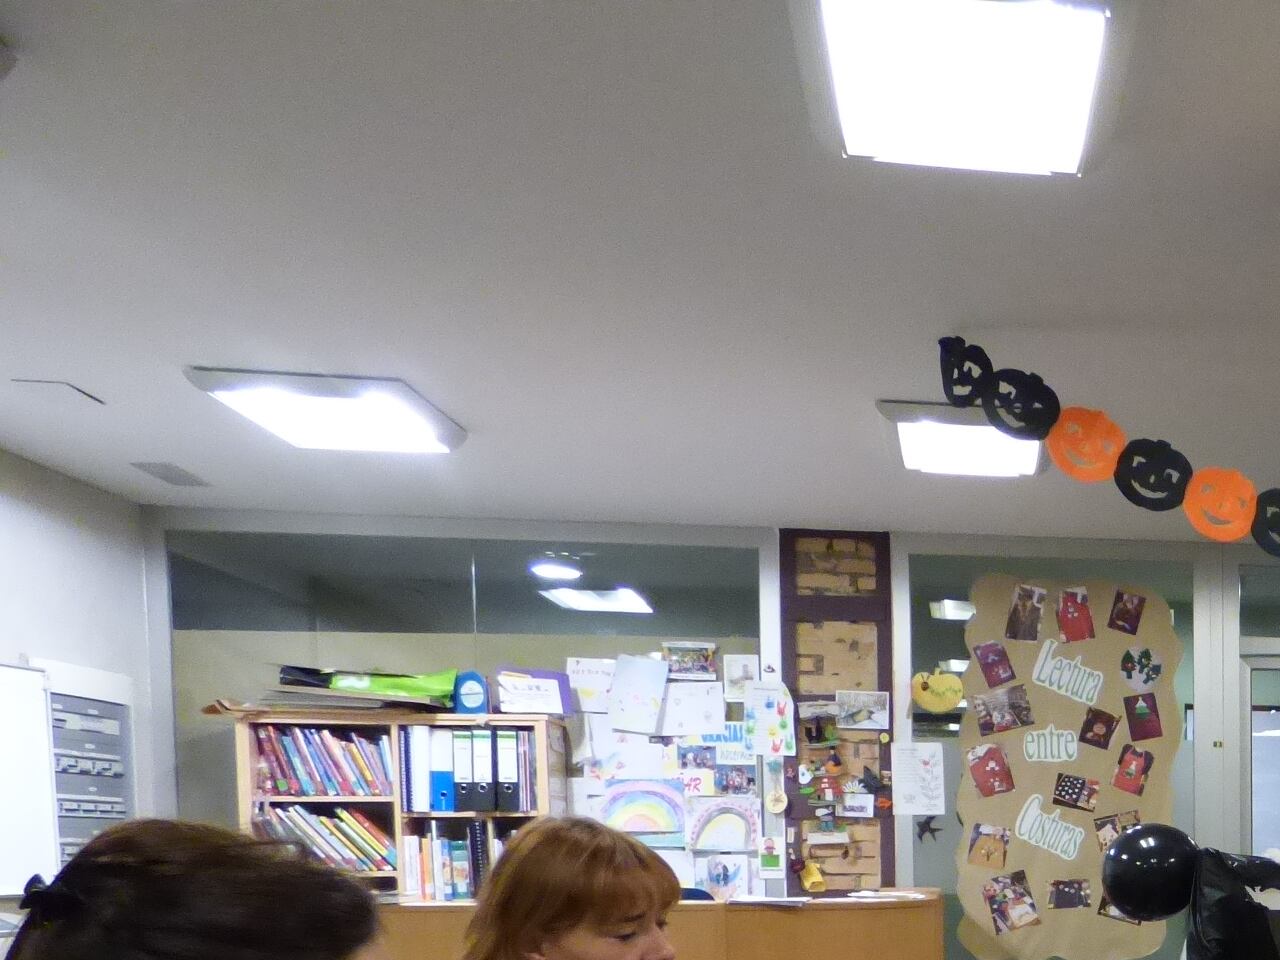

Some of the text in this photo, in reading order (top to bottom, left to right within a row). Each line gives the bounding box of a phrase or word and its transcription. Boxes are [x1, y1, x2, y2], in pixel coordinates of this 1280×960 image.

[1035, 639, 1101, 702] Lectura
[1025, 725, 1076, 760] entre
[1018, 795, 1083, 859] Costuras
